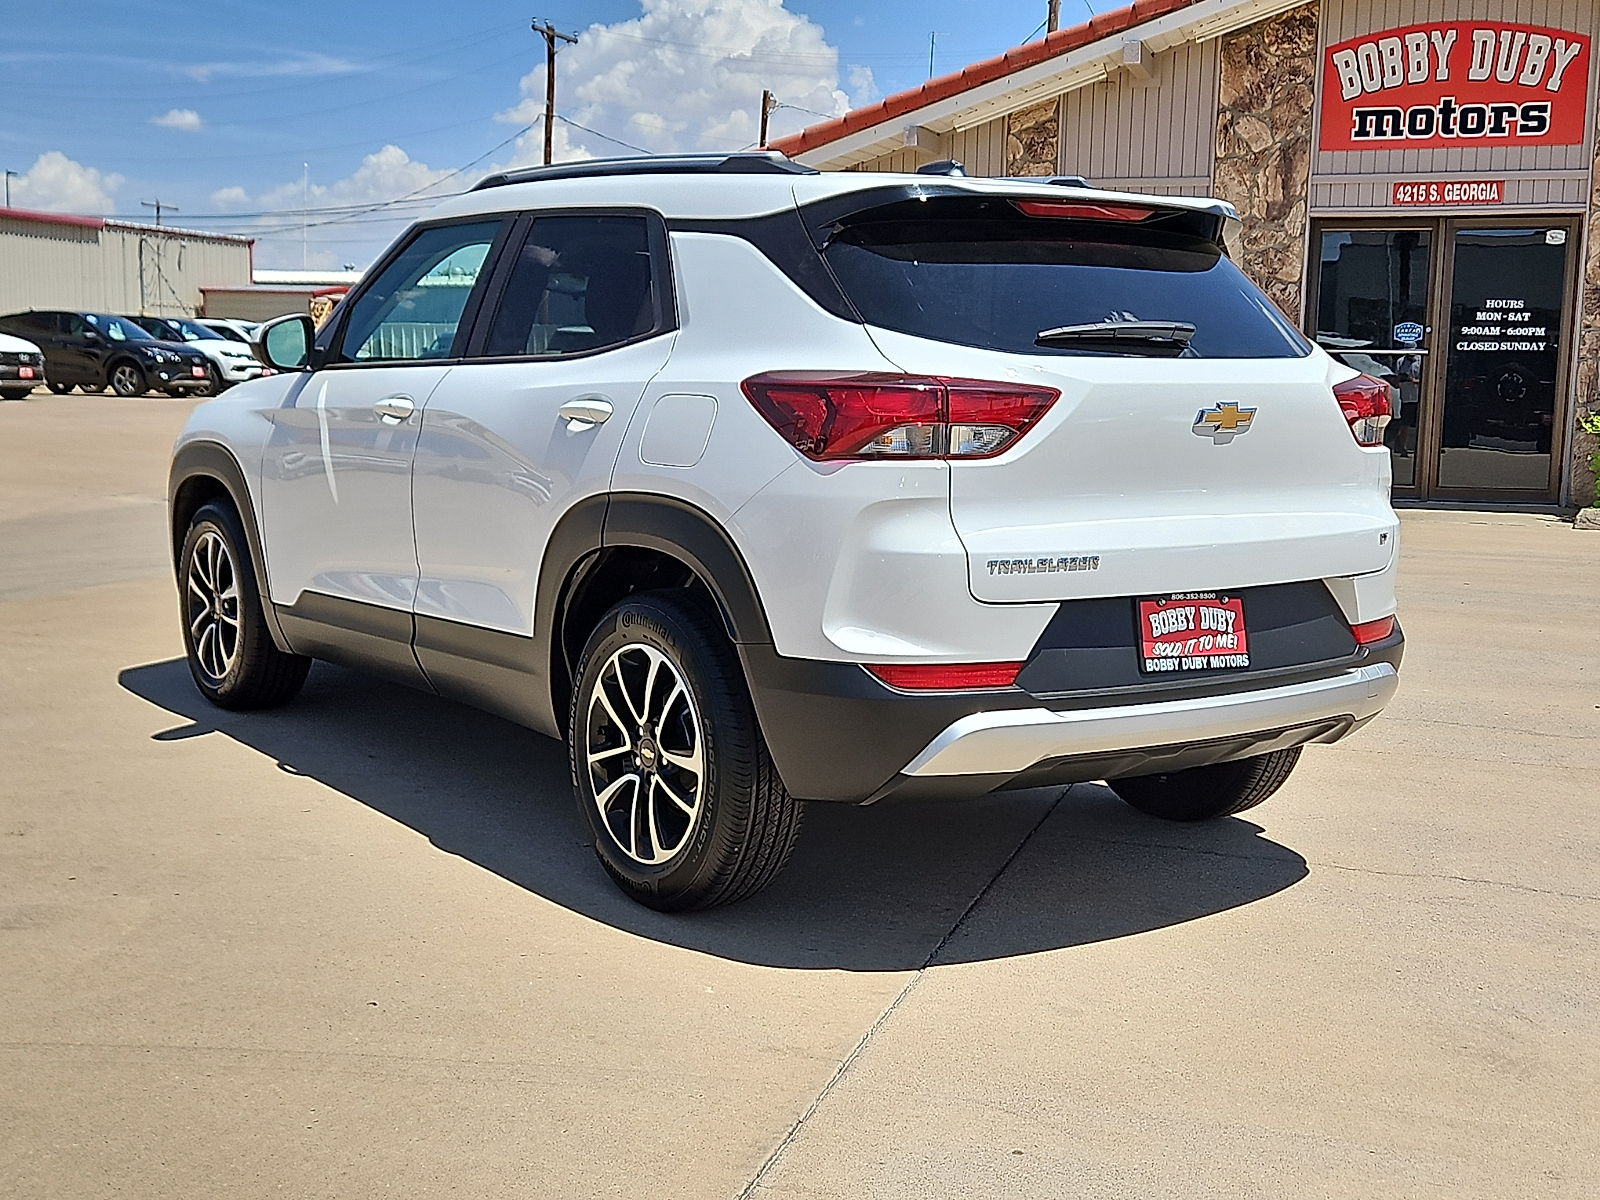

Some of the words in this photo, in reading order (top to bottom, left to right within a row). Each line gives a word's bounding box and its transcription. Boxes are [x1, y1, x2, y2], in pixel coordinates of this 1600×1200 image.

[1333, 29, 1458, 101] BOBBY
[1468, 28, 1582, 94] DUBY
[1351, 97, 1552, 141] motors
[1396, 185, 1426, 203] 4215
[1429, 185, 1441, 202] S.
[1444, 182, 1499, 202] GEORGIA
[1485, 299, 1524, 309] HOURS
[1456, 341, 1500, 351] CLOSED
[1500, 341, 1546, 351] SUNDAY
[986, 555, 1100, 576] TRAILBLAZER
[1149, 607, 1195, 638] BOBBY
[1199, 607, 1236, 634] DUBY
[1152, 641, 1182, 657] SOLD
[1184, 638, 1198, 655] IT
[1198, 634, 1213, 652] TO
[1215, 632, 1238, 650] ME!
[1145, 658, 1180, 672] BOBBY
[1181, 656, 1208, 669] DUBY
[1210, 654, 1250, 668] MOTORS
